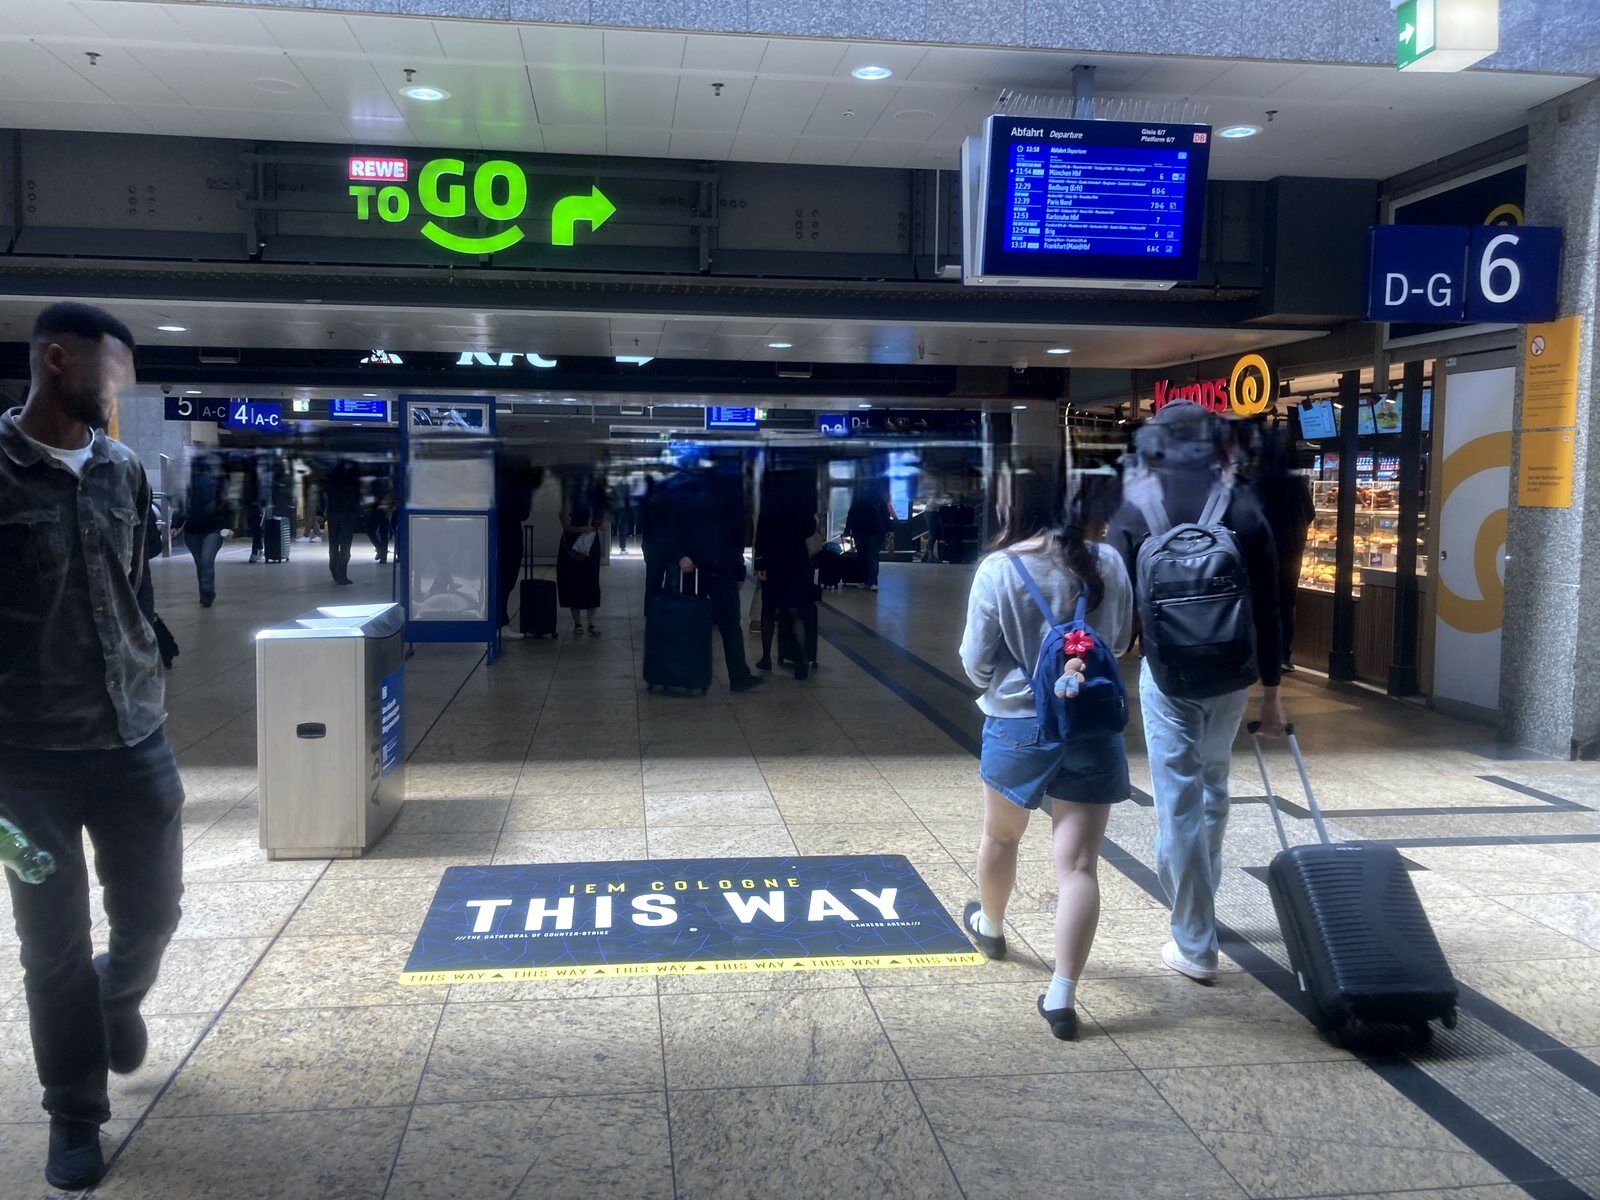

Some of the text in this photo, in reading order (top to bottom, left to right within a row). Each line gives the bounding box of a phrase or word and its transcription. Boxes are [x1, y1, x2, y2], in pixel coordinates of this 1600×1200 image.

[1010, 127, 1083, 139] Abfahrt Departure
[1194, 134, 1206, 142] DB
[351, 160, 404, 178] REWE
[350, 158, 528, 222] TO GO
[1048, 184, 1069, 192] Bedburg
[1045, 228, 1055, 236] Brig
[1384, 234, 1520, 306] D-G 6
[178, 398, 226, 417] 5 A-C
[234, 404, 279, 426] 4 A-C
[569, 878, 800, 894] IEM COLOGNE
[466, 888, 900, 933] THIS WAY
